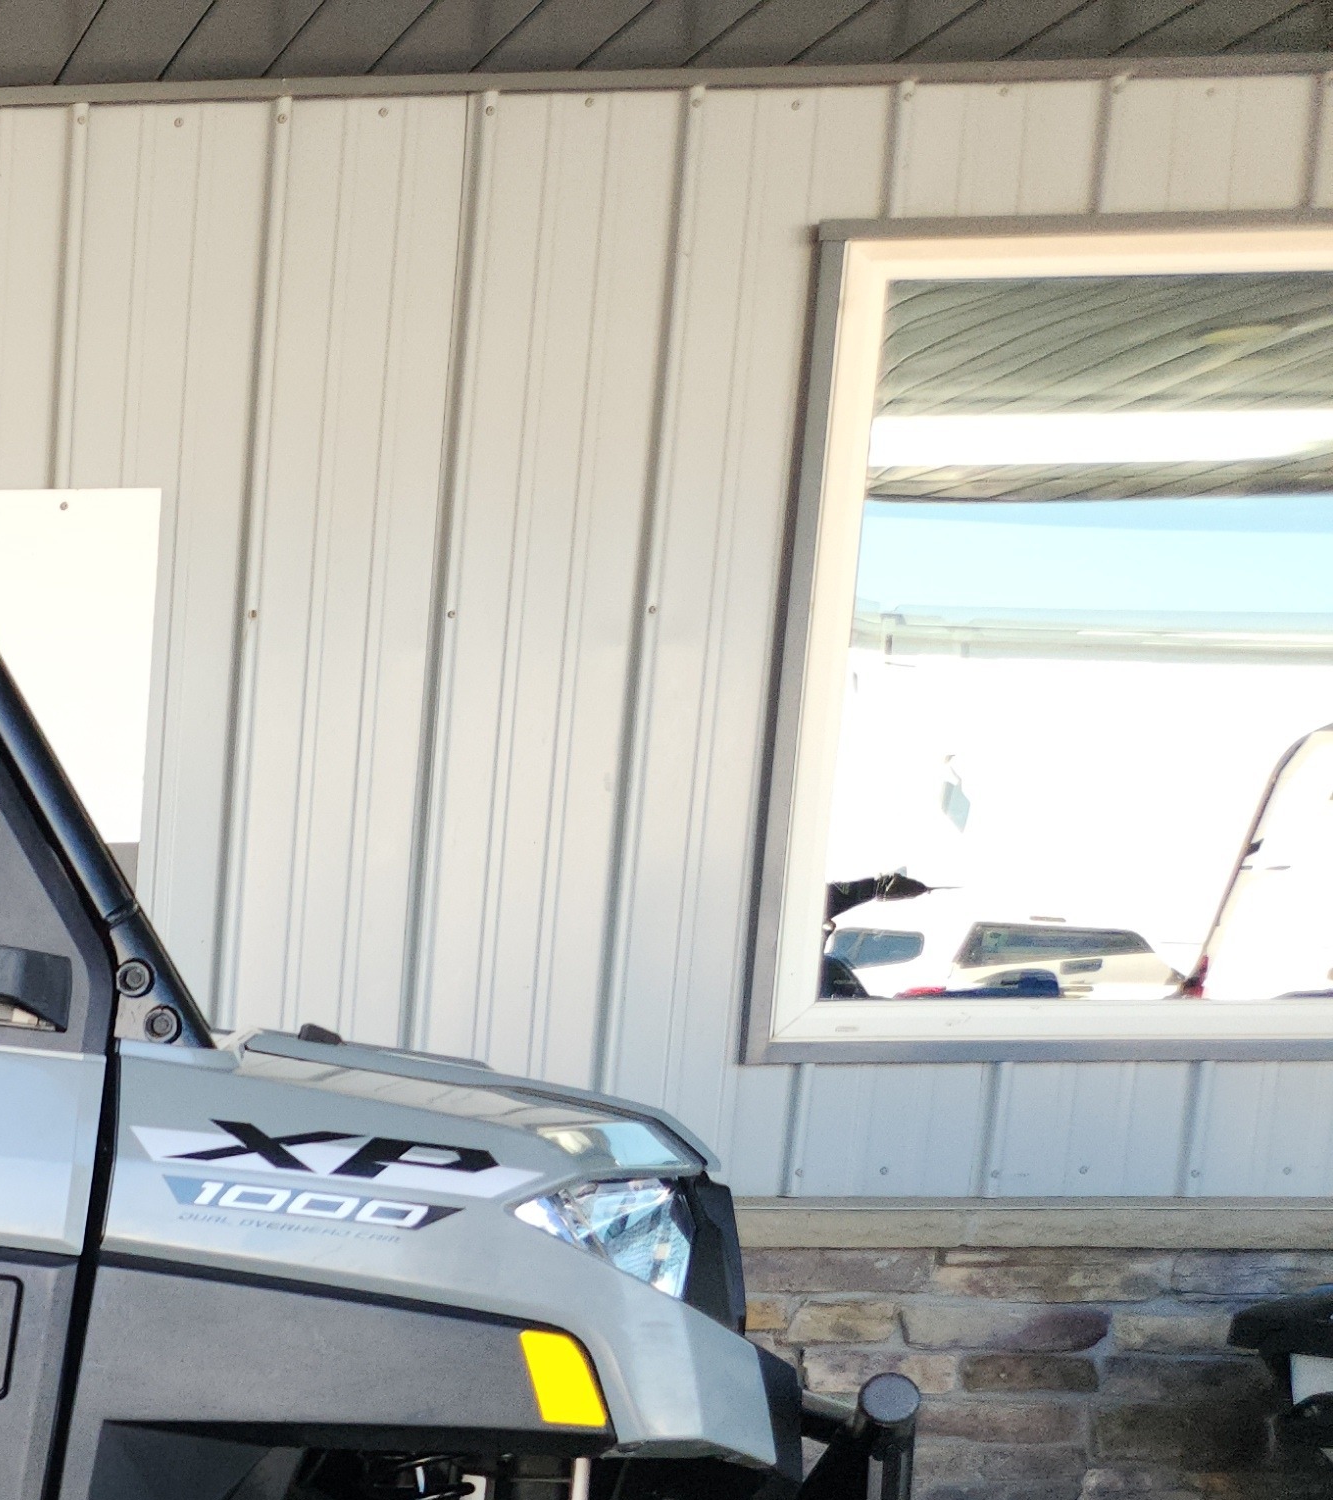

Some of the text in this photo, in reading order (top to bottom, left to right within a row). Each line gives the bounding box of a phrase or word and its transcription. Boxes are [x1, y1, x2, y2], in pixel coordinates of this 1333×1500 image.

[166, 1119, 500, 1179] XP
[178, 1213, 231, 1226] DUAL
[193, 1181, 430, 1229] 1000
